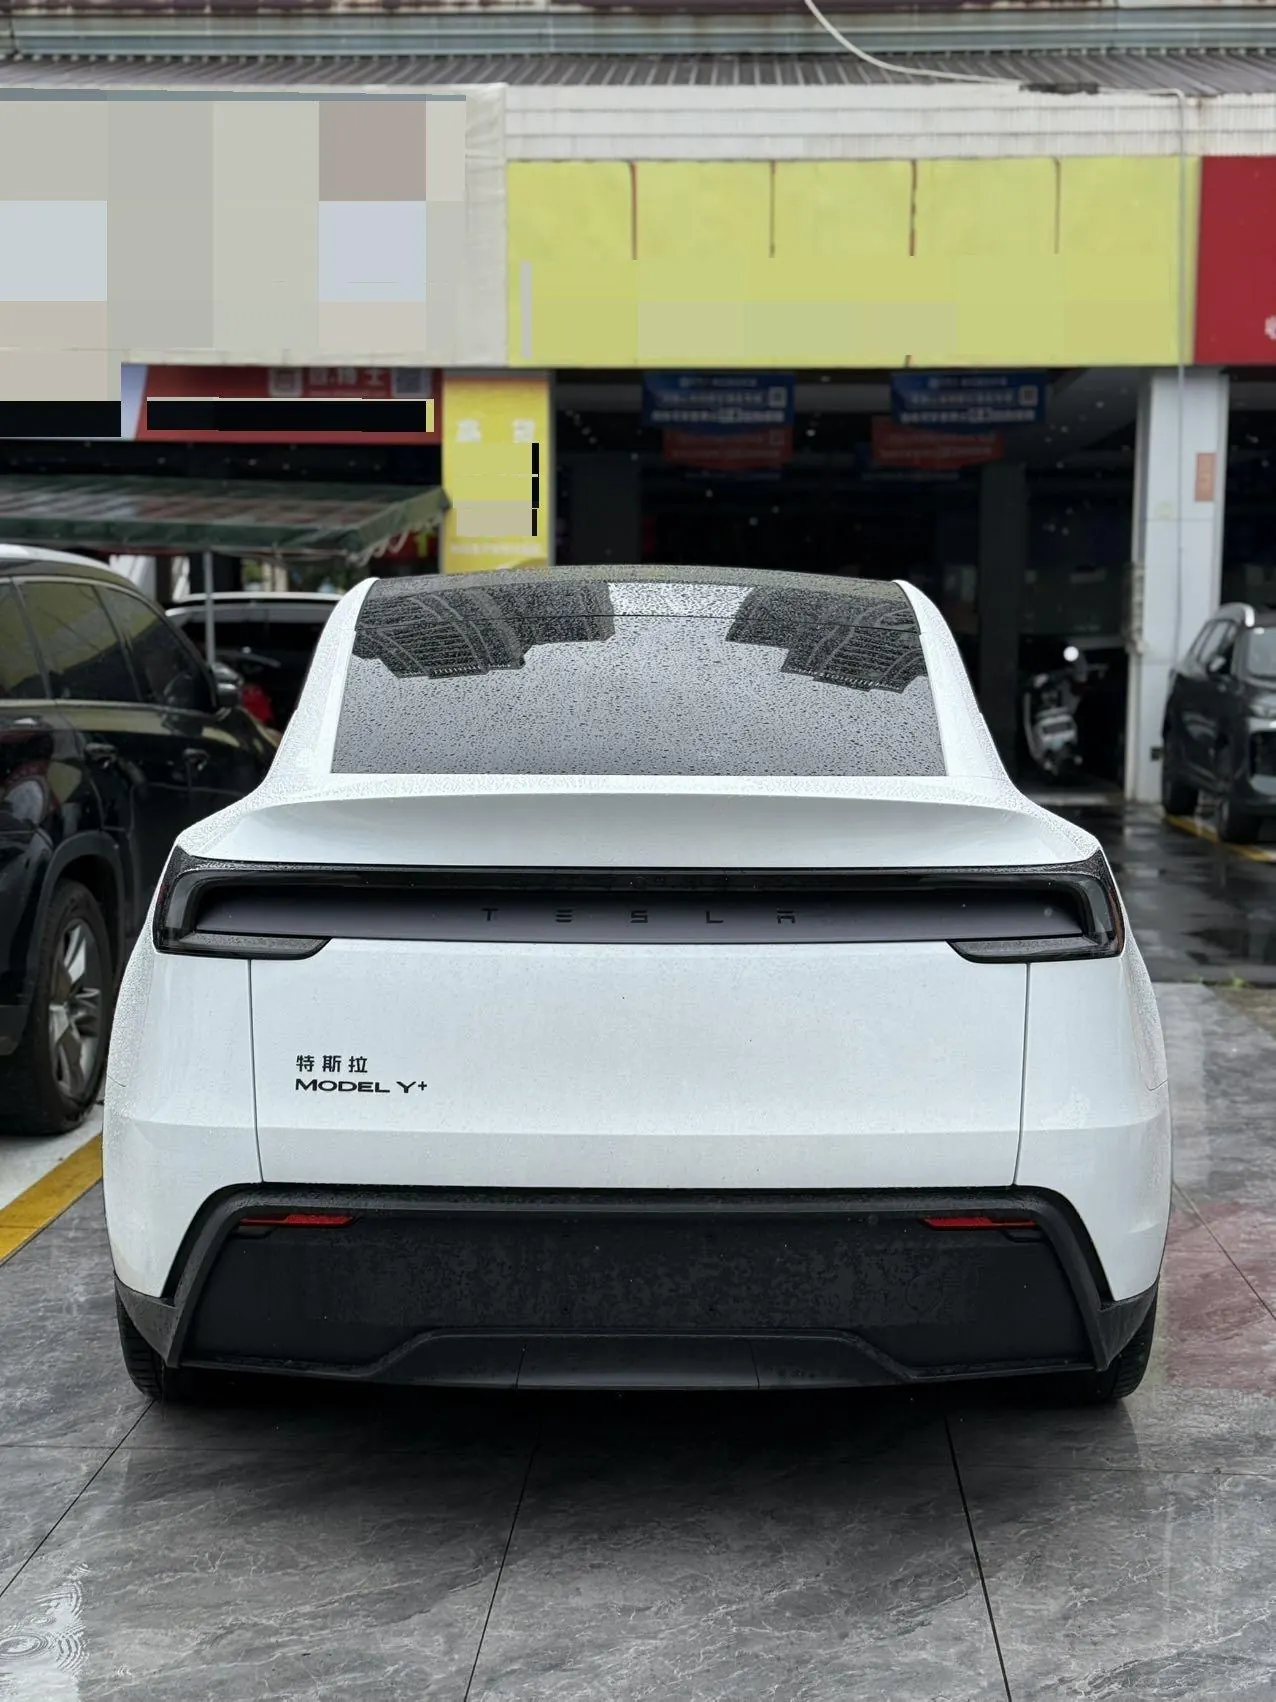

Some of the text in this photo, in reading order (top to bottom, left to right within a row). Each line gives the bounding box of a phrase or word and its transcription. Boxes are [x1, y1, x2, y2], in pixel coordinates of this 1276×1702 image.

[482, 908, 796, 924] TESLA
[295, 1055, 368, 1073] 特斯拉
[295, 1078, 391, 1093] MODEL
